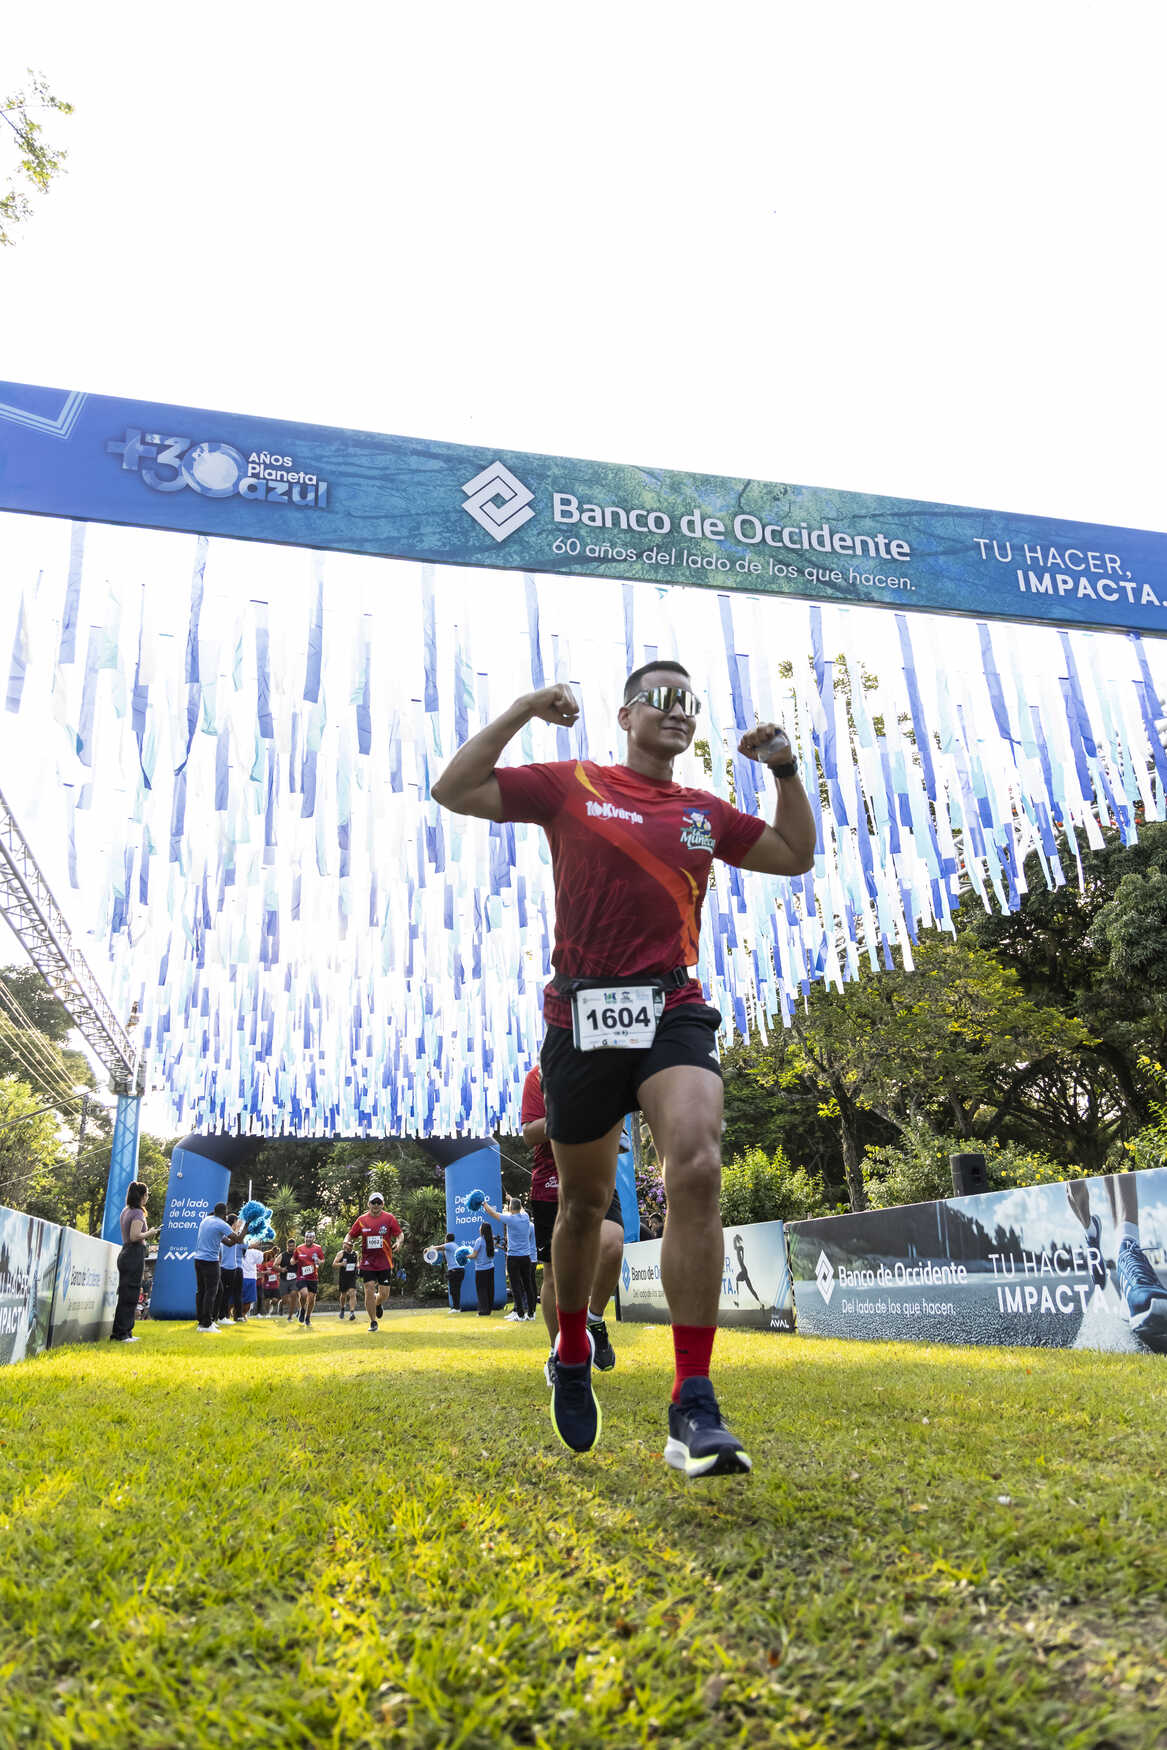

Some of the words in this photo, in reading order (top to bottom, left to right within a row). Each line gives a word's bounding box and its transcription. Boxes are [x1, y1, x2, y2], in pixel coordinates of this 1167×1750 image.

[248, 451, 293, 467] AÑOS
[247, 463, 317, 485] Planeta
[238, 477, 328, 508] azul
[552, 492, 671, 534] Banco
[680, 509, 726, 540] de
[733, 514, 911, 561] Occidente
[552, 537, 581, 556] 60
[585, 543, 637, 562] años
[643, 547, 676, 566] del
[683, 550, 730, 571] lado
[735, 552, 762, 574] de
[769, 558, 798, 578] los
[804, 566, 842, 585] que
[849, 567, 916, 591] hacen.
[973, 537, 1012, 562] TU
[1023, 543, 1132, 579] HACER,
[1016, 569, 1167, 607] IMPACTA.
[587, 1006, 650, 1030] 1604
[169, 1208, 180, 1217] de
[181, 1208, 195, 1217] los
[170, 1198, 184, 1208] Del
[186, 1198, 208, 1208] lado
[168, 1219, 198, 1229] hacen.
[838, 1265, 875, 1287] Banco
[876, 1263, 893, 1286] de
[894, 1260, 968, 1285] Occidente
[988, 1252, 1015, 1279] TU
[1022, 1247, 1111, 1280] HACER,
[842, 1299, 855, 1313] Del
[856, 1298, 875, 1314] lado
[875, 1299, 887, 1313] de
[888, 1297, 901, 1313] los
[903, 1302, 921, 1316] que
[922, 1299, 957, 1315] hacen.
[997, 1283, 1120, 1314] IMPACTA.
[770, 1319, 789, 1328] AVAL
